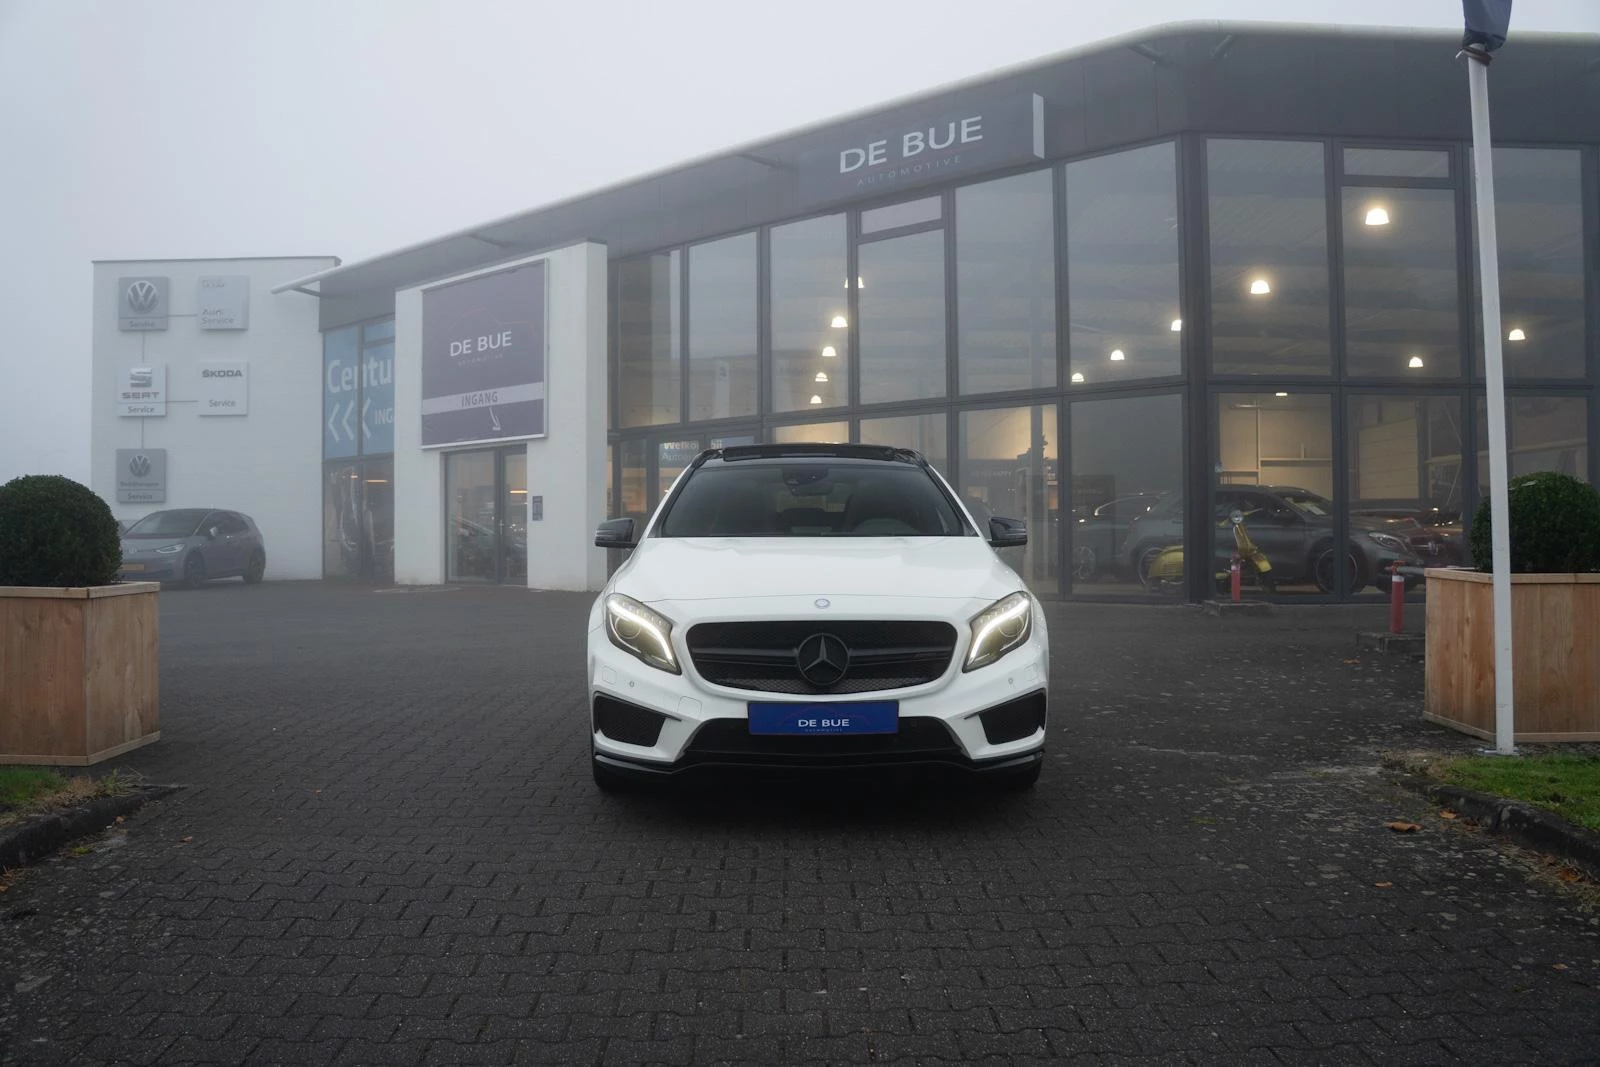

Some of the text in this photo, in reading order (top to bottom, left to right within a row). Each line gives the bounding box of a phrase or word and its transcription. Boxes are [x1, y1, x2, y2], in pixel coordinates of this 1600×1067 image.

[840, 116, 983, 174] DE BUE
[857, 155, 962, 186] AUTOMOTIVE
[449, 331, 512, 357] DE BUE
[208, 399, 236, 408] Service
[461, 391, 499, 408] INGANG
[127, 405, 155, 414] Service
[798, 719, 850, 727] DE BUE
